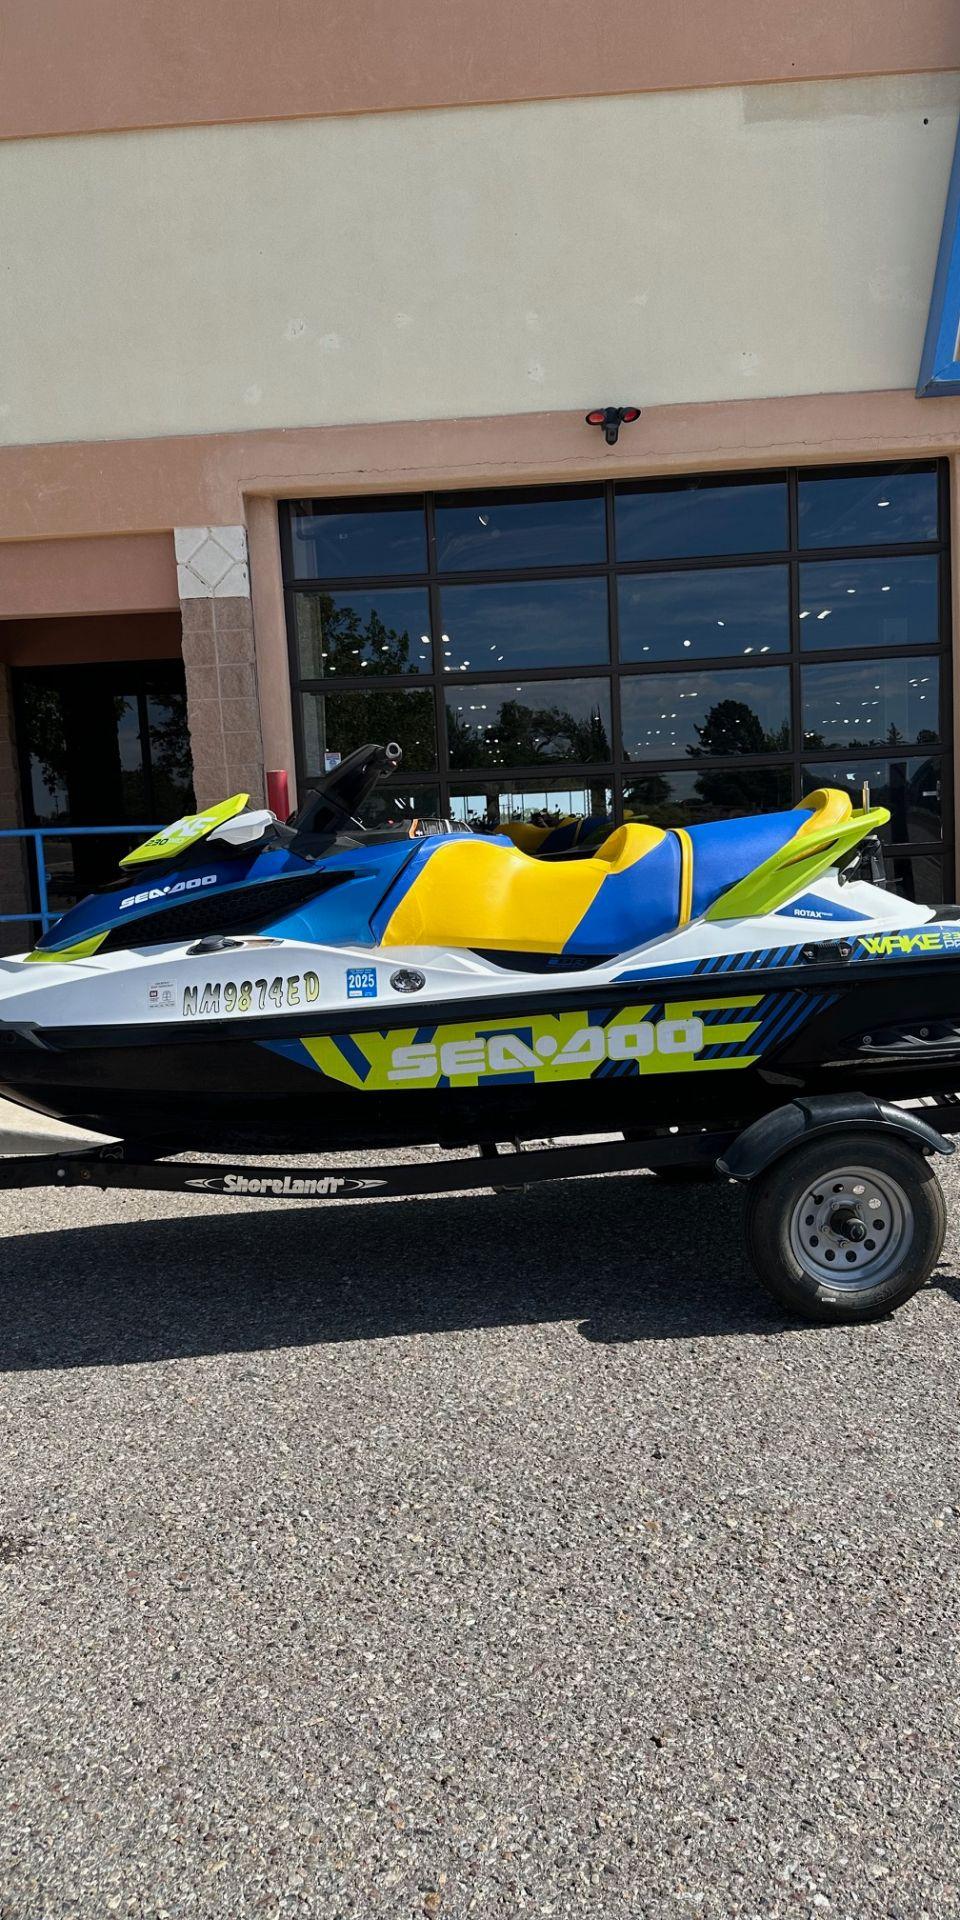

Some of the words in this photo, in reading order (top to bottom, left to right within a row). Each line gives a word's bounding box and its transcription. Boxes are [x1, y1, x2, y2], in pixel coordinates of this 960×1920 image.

[145, 839, 169, 848] 230
[794, 909, 822, 918] ROTAX
[858, 933, 943, 955] WAKE
[348, 973, 375, 989] 2025
[183, 971, 320, 1016] NM9874ED
